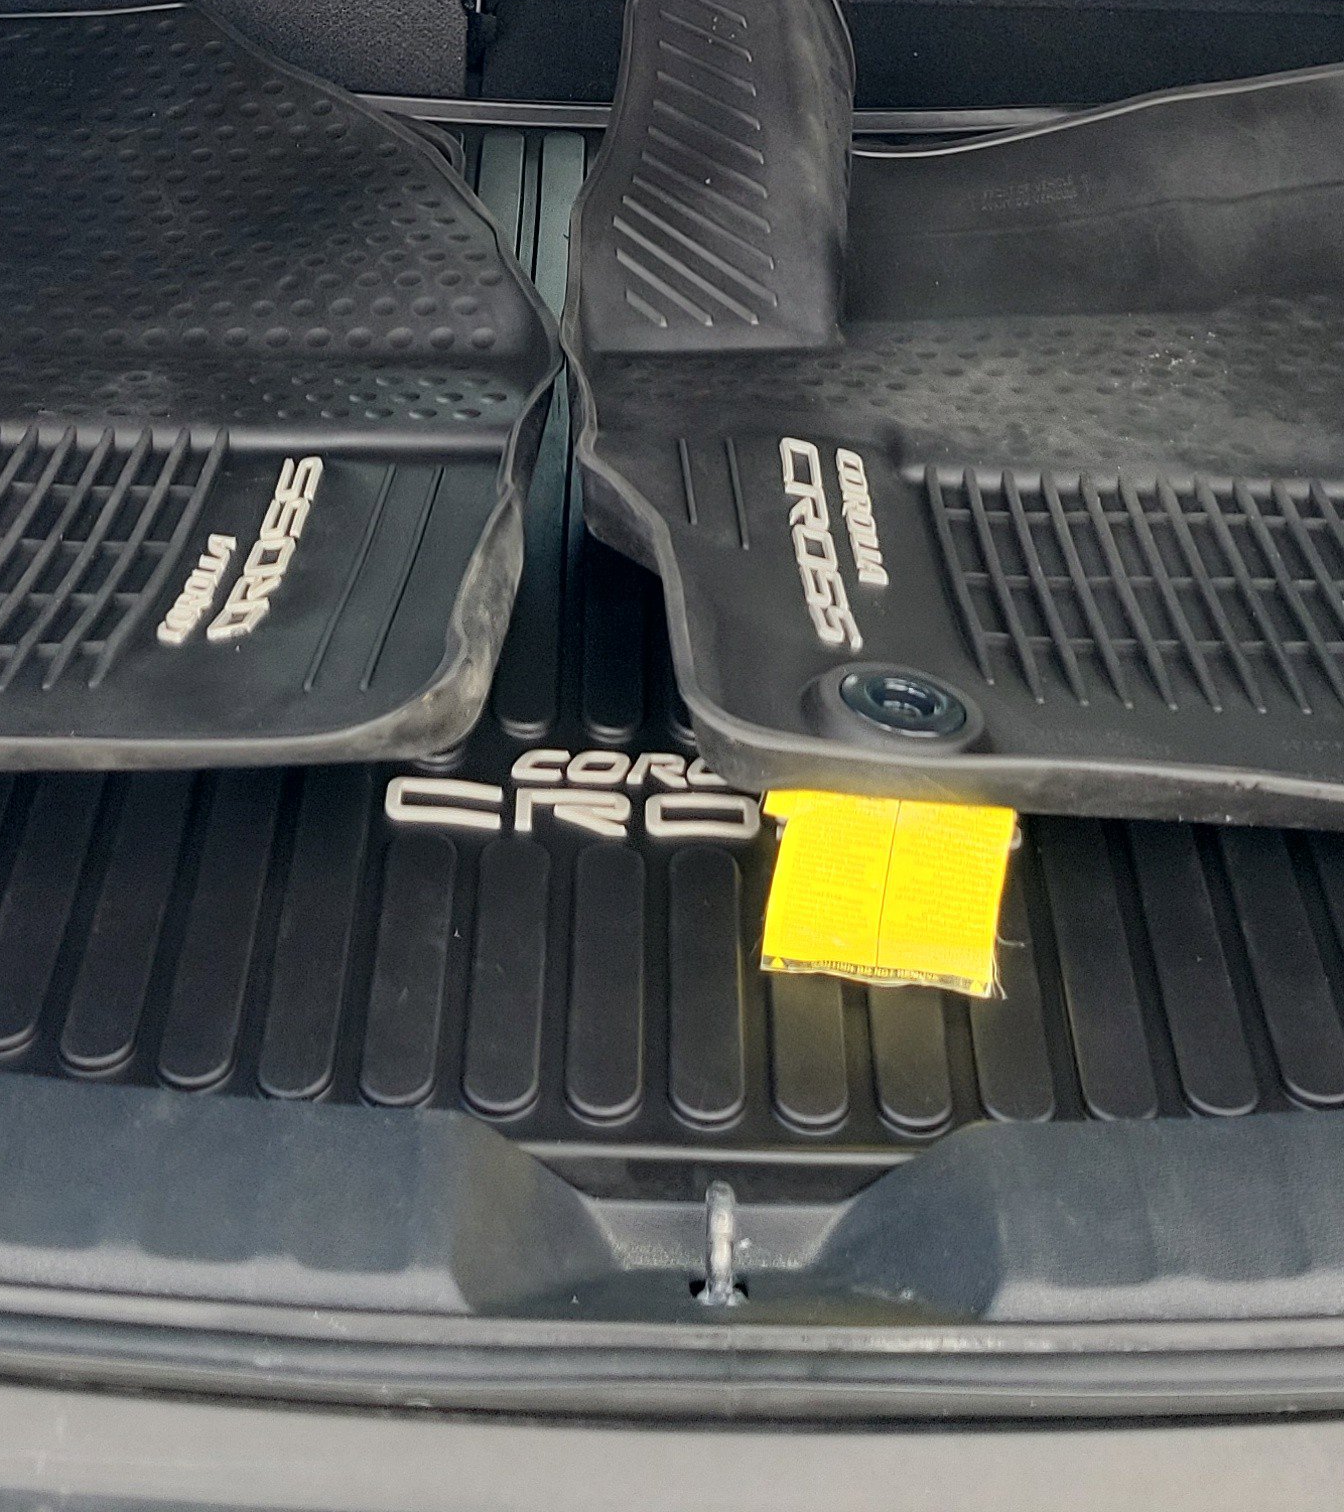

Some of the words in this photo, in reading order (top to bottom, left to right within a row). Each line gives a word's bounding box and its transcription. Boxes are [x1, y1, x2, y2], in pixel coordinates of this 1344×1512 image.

[207, 456, 324, 641] CROSS
[780, 436, 864, 651] CROSS
[384, 776, 788, 840] CRO
